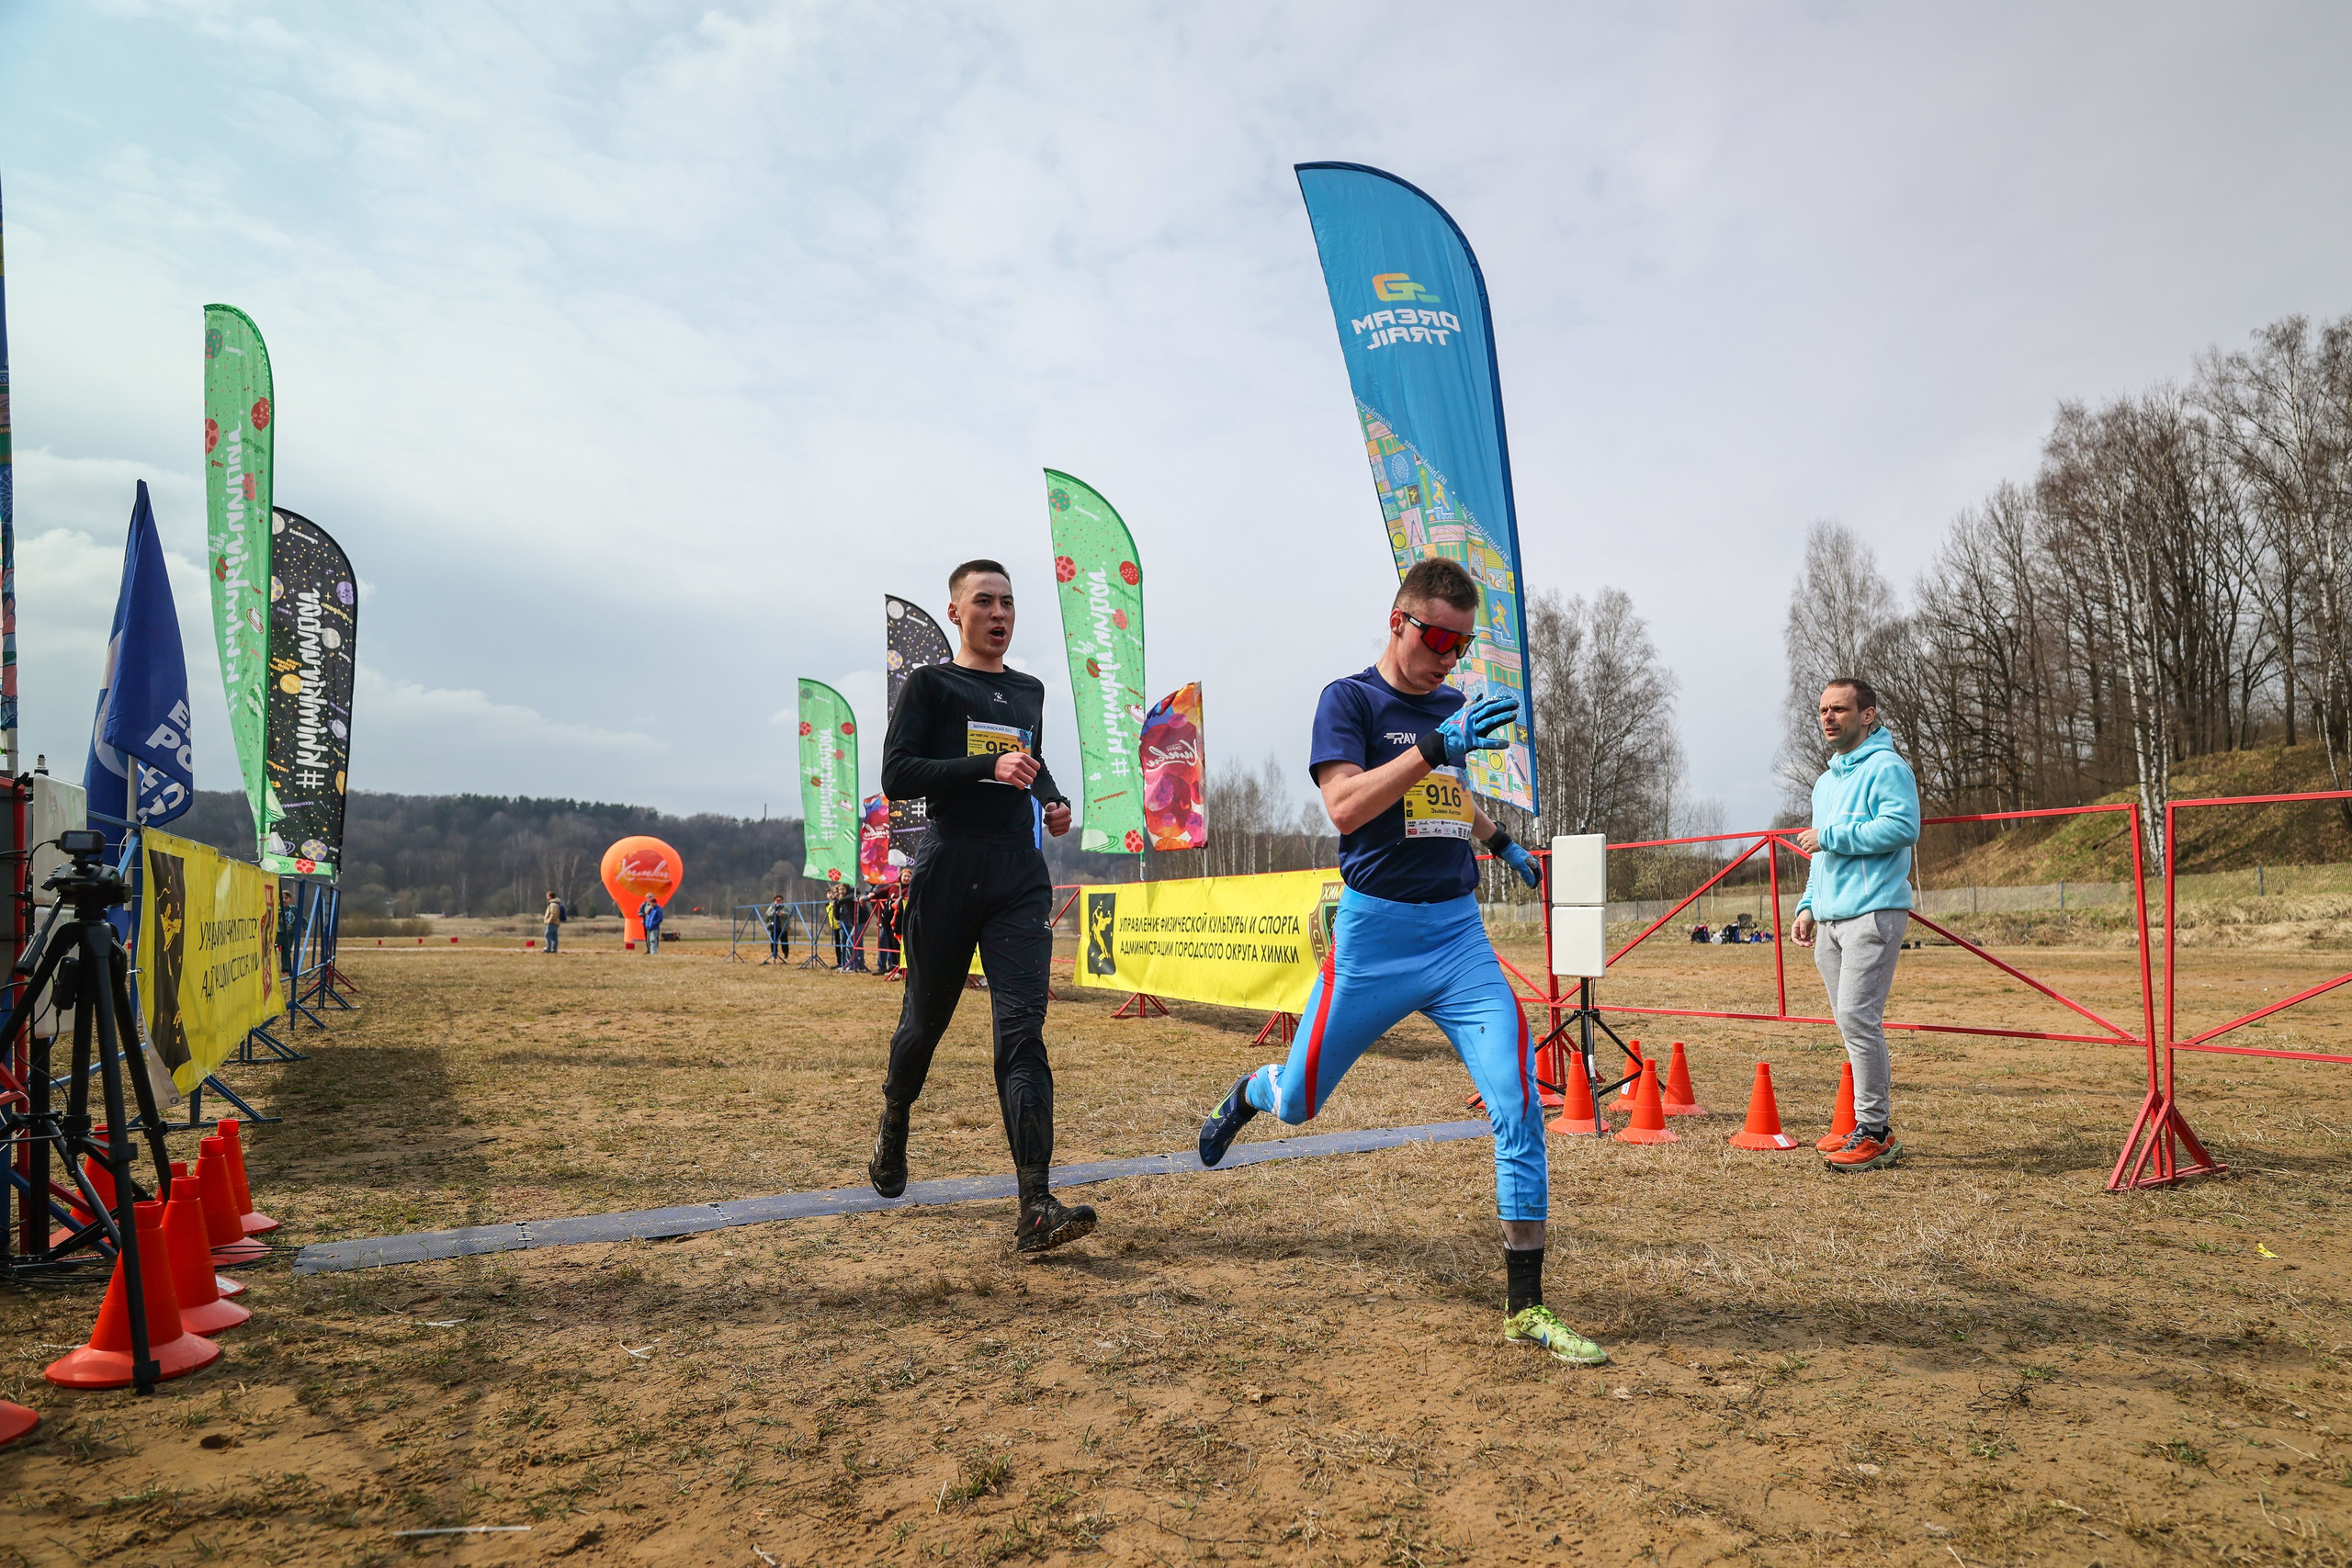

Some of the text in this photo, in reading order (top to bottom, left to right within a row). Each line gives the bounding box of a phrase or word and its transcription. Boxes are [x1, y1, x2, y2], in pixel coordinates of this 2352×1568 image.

[1426, 784, 1462, 807] 916
[1321, 885, 1345, 900] ХИМ
[1119, 912, 1300, 935] УПРАВЛЕНИЕ ФИЗИЧЕСКОЙ КУЛЬТУРЫ И СПОРТА
[1120, 940, 1300, 964] АДМИНИСТРАЦИИ ГОРОДСКОГО ОКРУГА ХИМКИ
